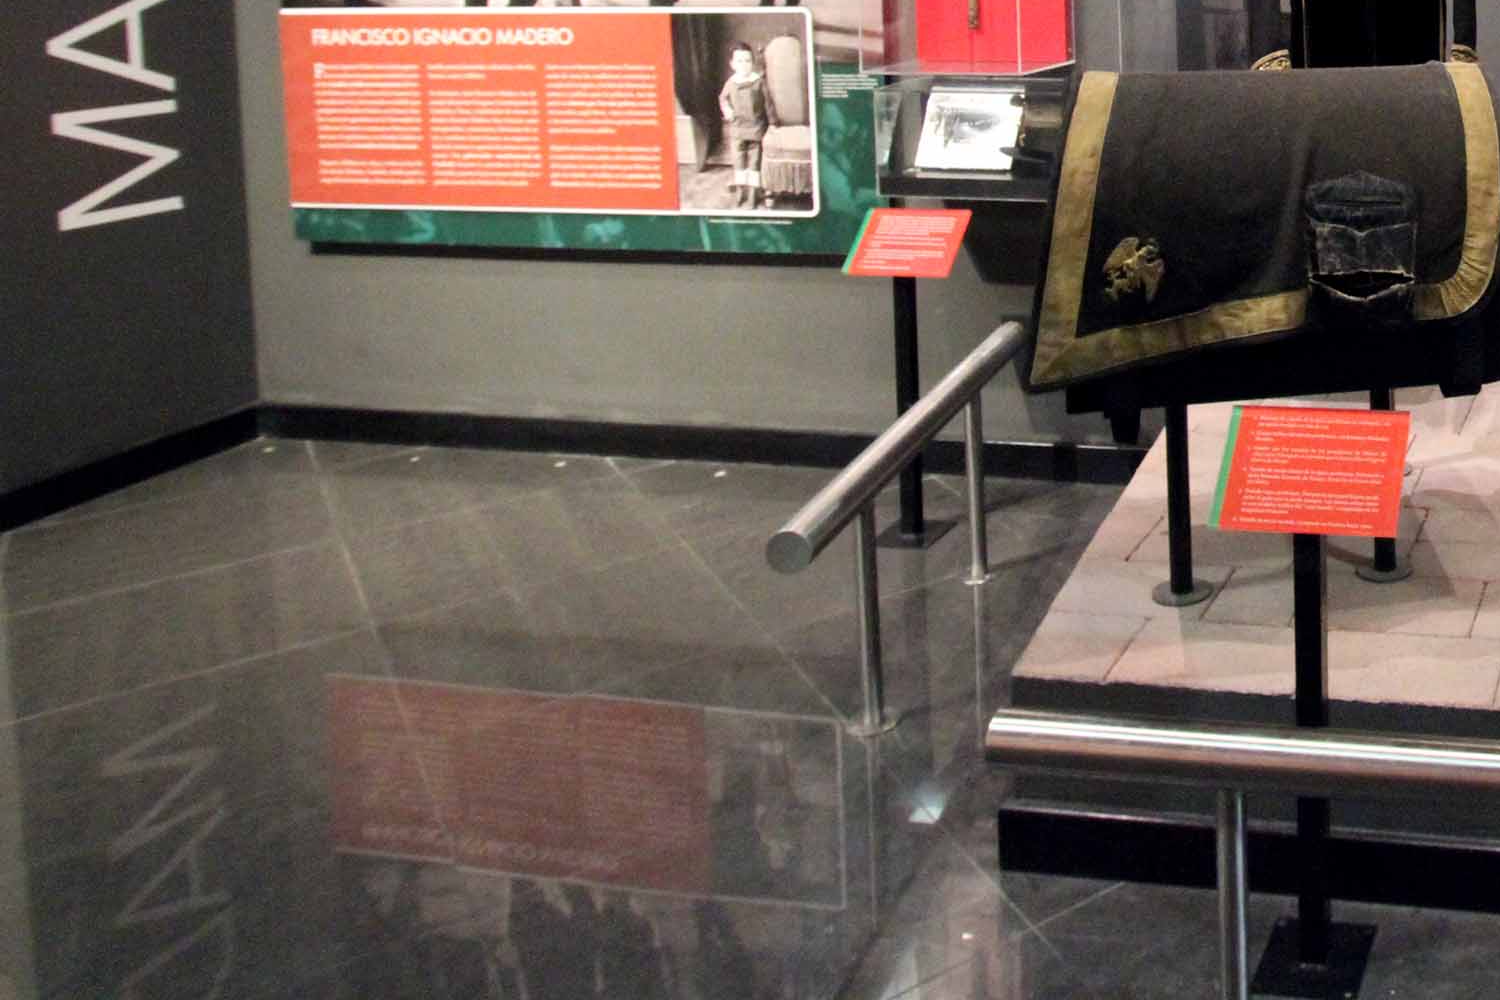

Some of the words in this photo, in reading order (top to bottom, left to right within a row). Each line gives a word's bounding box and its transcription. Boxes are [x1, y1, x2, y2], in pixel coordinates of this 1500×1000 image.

[311, 27, 410, 46] FRANCISCO
[413, 27, 492, 46] IGNACIO
[495, 27, 574, 46] MADERO
